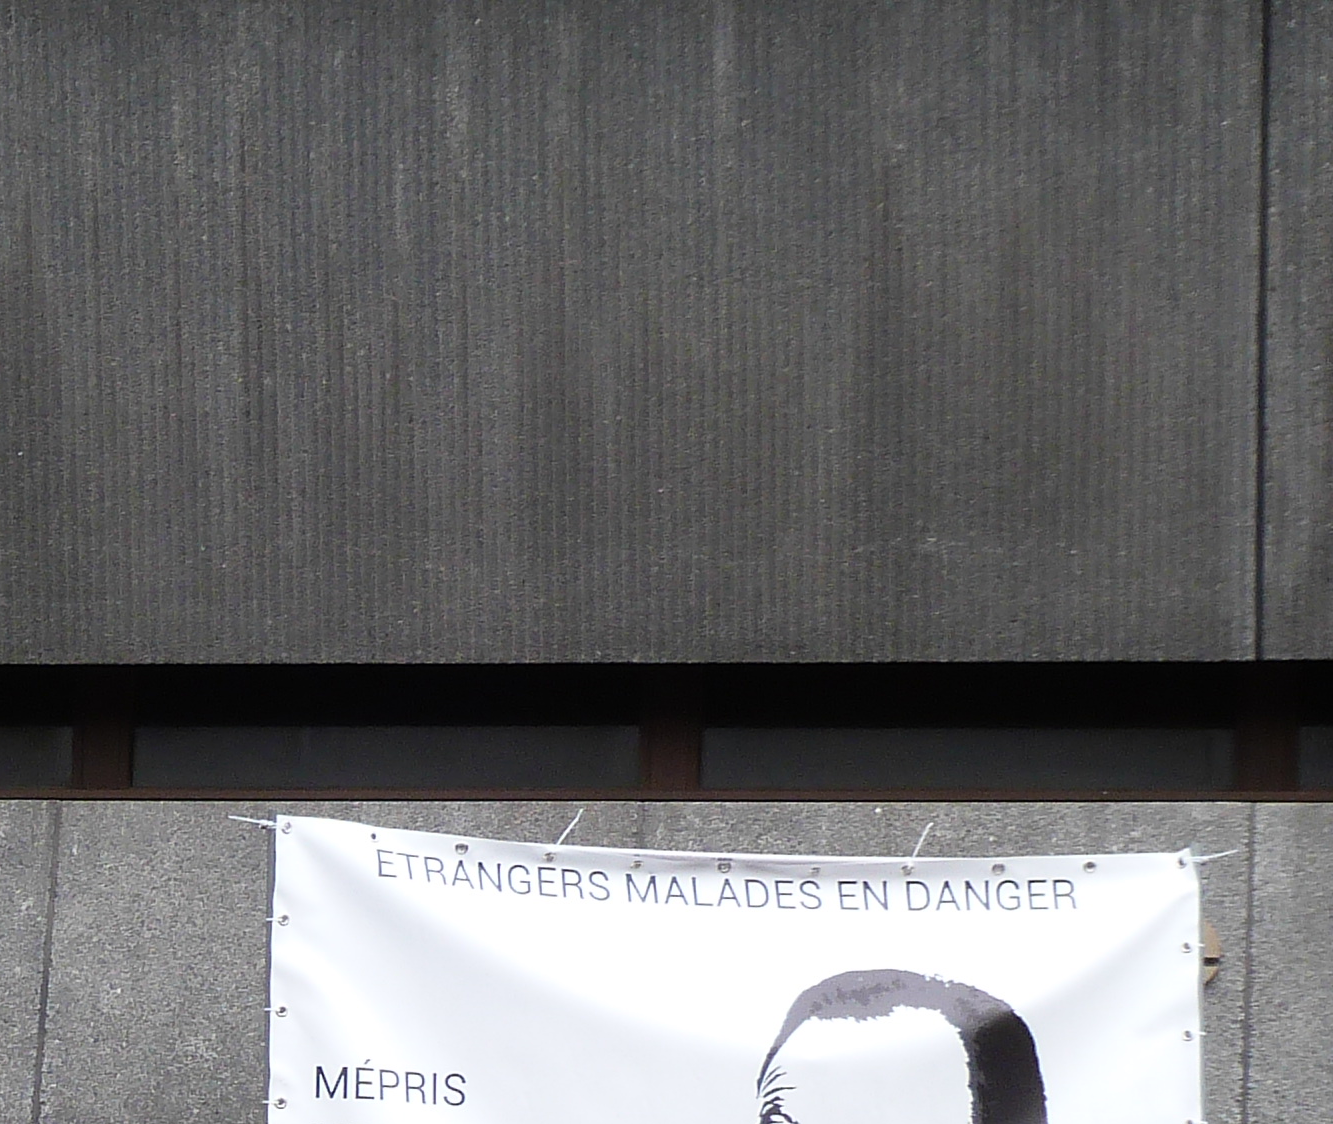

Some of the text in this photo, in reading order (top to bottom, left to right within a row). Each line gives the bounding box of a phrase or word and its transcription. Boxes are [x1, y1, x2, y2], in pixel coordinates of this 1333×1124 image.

[377, 850, 1076, 911] ETRANGERS MALADES EN DANGER
[315, 1059, 466, 1106] MÉPRIS
